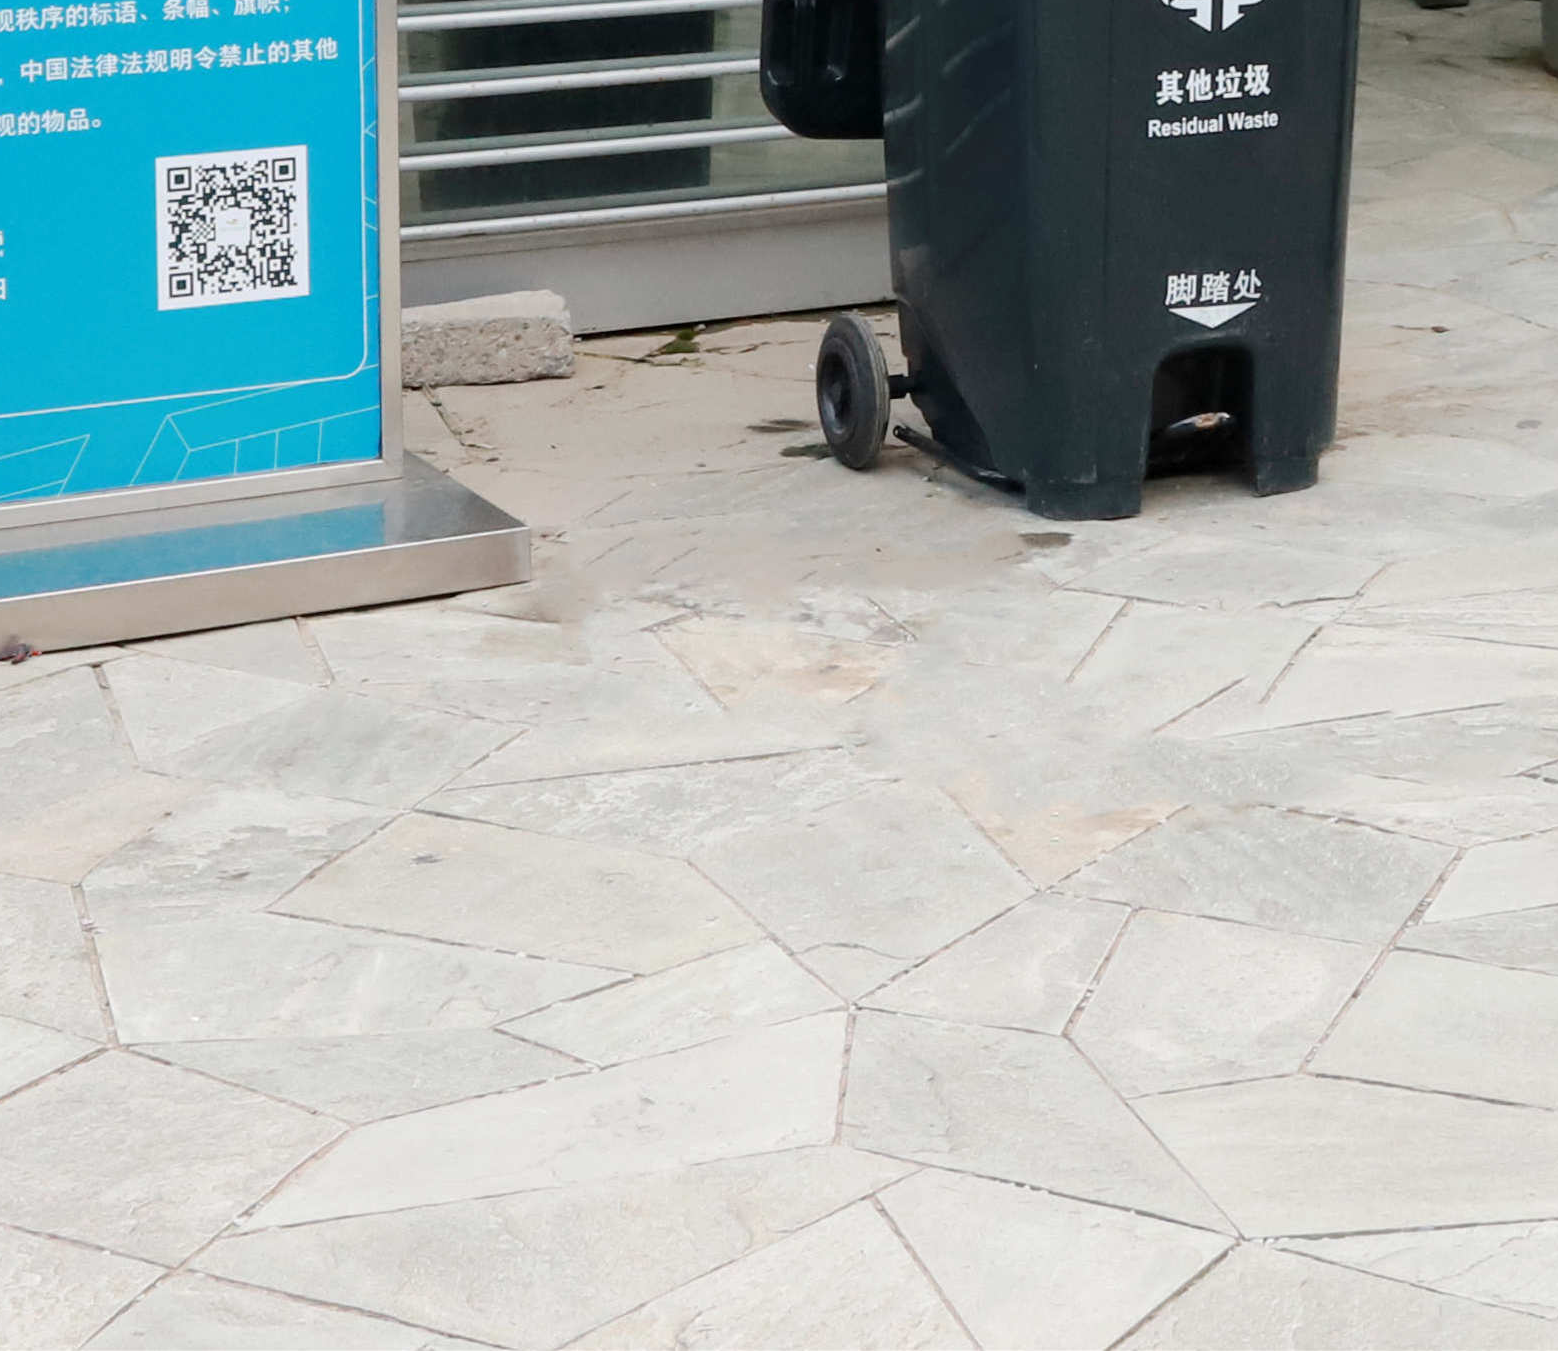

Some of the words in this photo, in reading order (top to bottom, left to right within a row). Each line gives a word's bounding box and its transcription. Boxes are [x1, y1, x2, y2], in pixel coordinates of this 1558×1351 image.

[1156, 64, 1271, 105] 其他垃圾
[1147, 114, 1223, 138] Residual
[1227, 110, 1279, 131] Waste
[1165, 268, 1262, 305] 脚踏处
